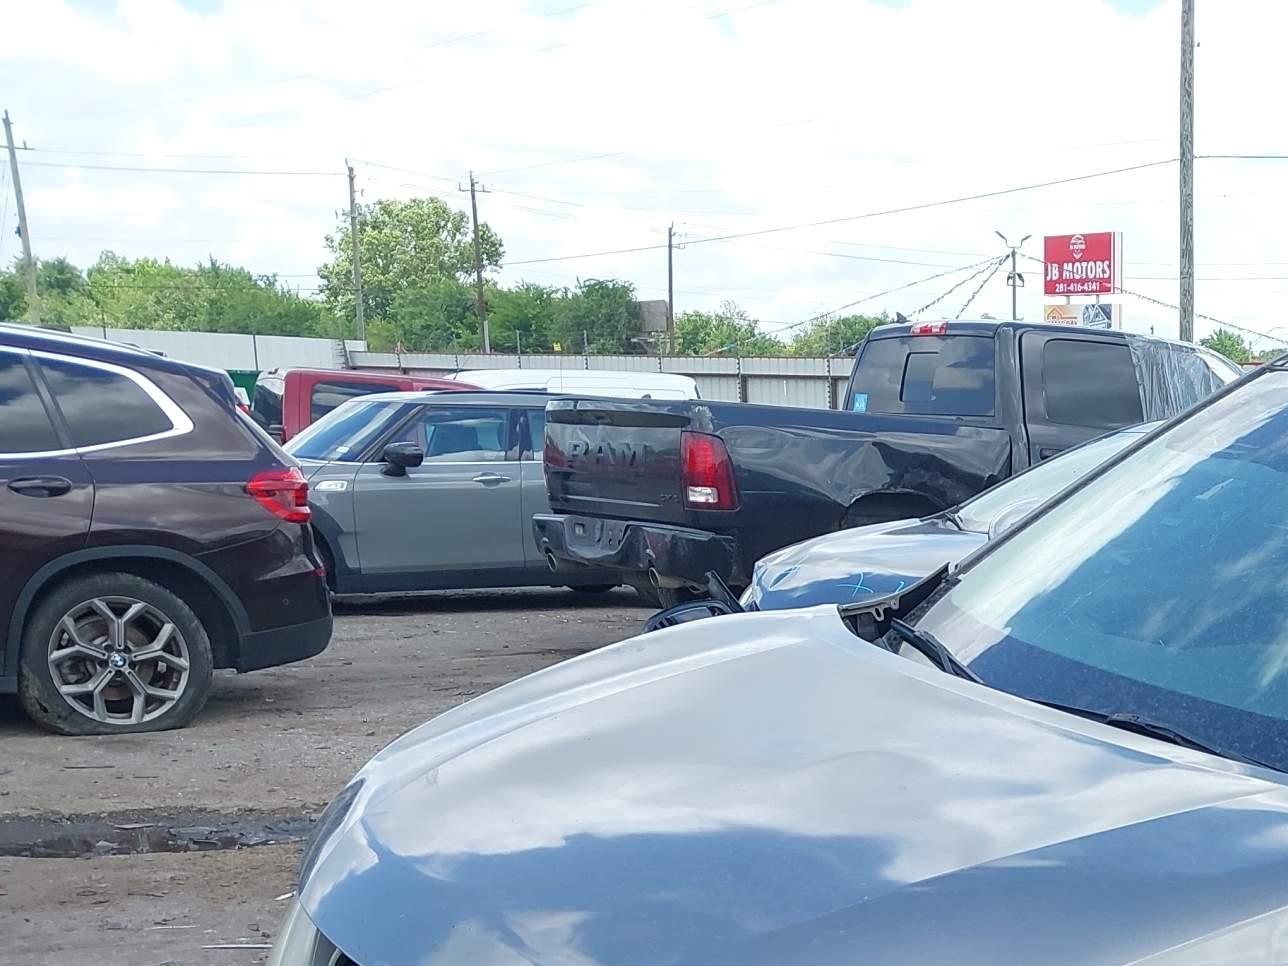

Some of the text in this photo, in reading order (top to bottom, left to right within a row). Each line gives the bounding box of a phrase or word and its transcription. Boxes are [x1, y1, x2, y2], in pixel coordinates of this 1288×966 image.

[1046, 261, 1109, 280] JB MOTORS
[567, 440, 650, 467] RAM
